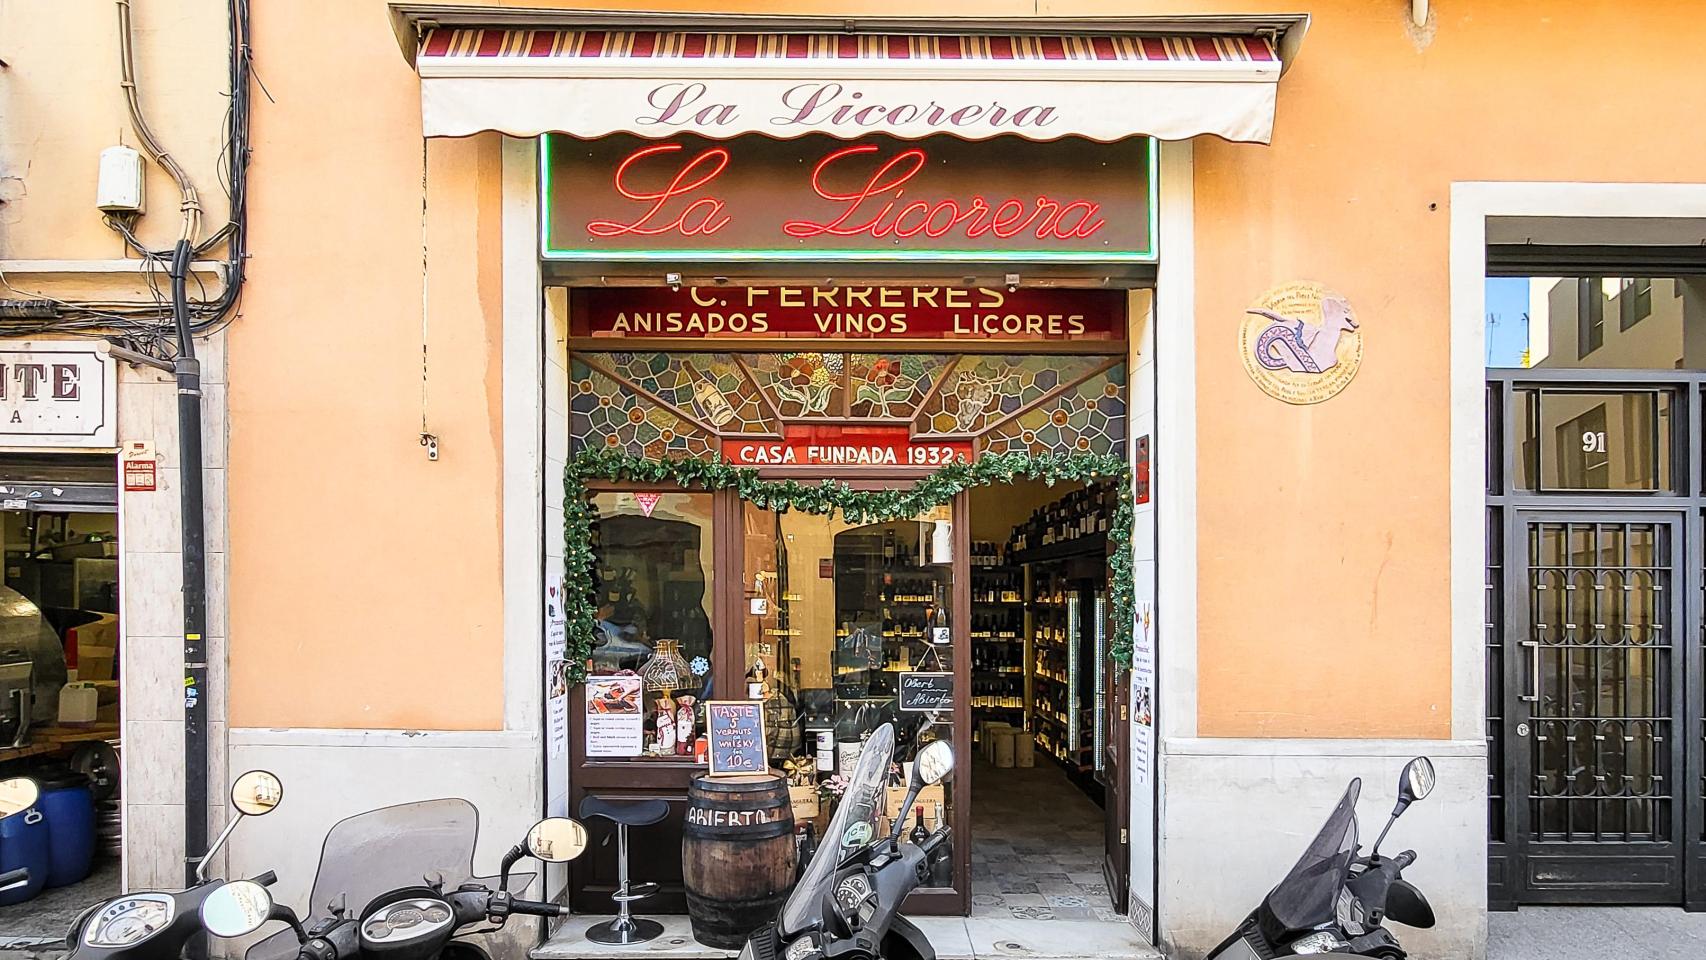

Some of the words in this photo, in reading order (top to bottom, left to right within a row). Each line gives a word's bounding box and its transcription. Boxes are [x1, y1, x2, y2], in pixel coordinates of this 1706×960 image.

[634, 82, 739, 126] La
[769, 82, 1060, 128] Licorera
[587, 144, 731, 239] La
[783, 144, 1106, 241] Licorera
[747, 287, 1006, 309] FERRERES
[612, 312, 769, 334] ANISADOS
[814, 312, 908, 334] VINOS
[953, 313, 1086, 335] LICORES
[0, 363, 81, 402] TE
[1582, 431, 1606, 453] 91
[126, 462, 154, 470] Alarma
[739, 446, 797, 465] CASA
[807, 446, 897, 465] FUNDADA
[907, 446, 954, 465] 1932
[711, 706, 755, 718] TASTE
[729, 717, 740, 729] 5
[718, 739, 754, 748] WHISKY
